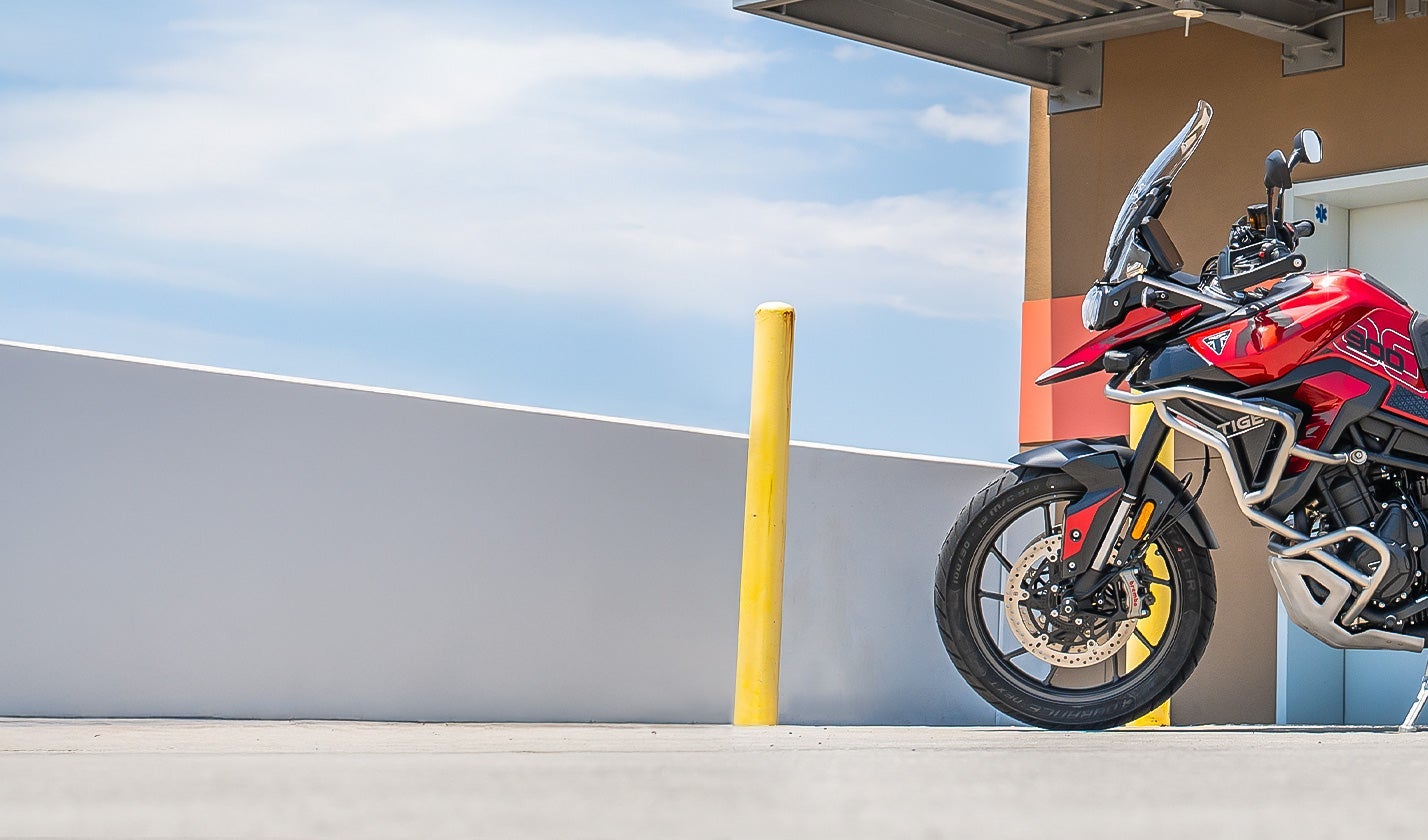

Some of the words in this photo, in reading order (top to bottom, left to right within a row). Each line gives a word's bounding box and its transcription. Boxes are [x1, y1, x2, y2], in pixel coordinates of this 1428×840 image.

[1345, 329, 1405, 374] 900
[1216, 414, 1269, 436] TIGE
[1128, 580, 1139, 607] brembo
